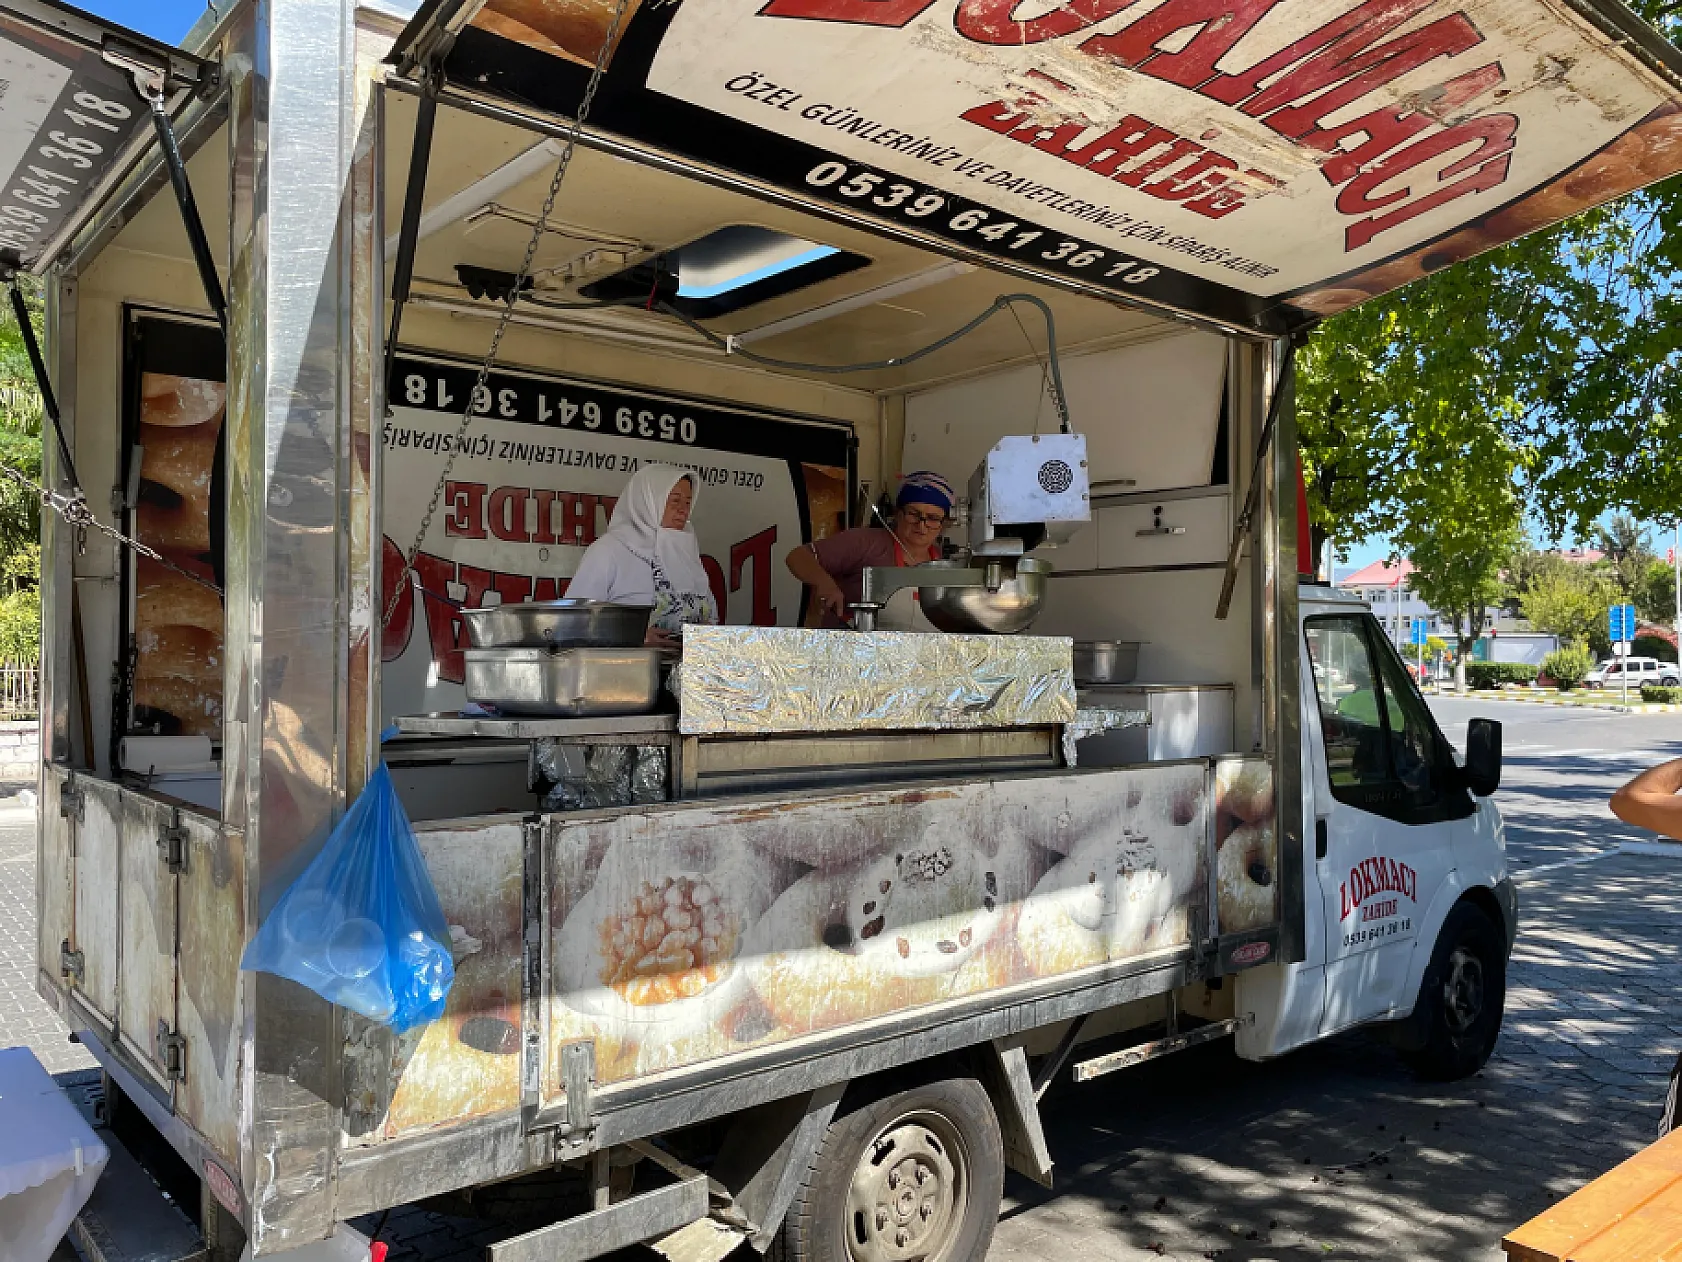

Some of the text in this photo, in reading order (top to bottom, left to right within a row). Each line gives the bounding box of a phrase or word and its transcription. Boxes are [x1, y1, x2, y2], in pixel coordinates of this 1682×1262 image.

[64, 91, 132, 133] 18
[755, 0, 1519, 252] KMACI
[39, 130, 103, 169] 36
[724, 71, 803, 110] ÖZEL
[800, 103, 963, 166] GÜNLERİNİZ
[953, 157, 996, 178] VE
[982, 170, 1134, 229] DAVETLERİNİZ
[12, 165, 79, 209] 641
[805, 161, 1160, 285] 0539 641 36 18
[404, 373, 697, 443] 0539 641 36 18
[499, 441, 616, 470] DAVETLERİNİZ
[619, 455, 638, 474] VE
[732, 470, 764, 492] ÖZEL
[1340, 856, 1417, 923] LOKMACI
